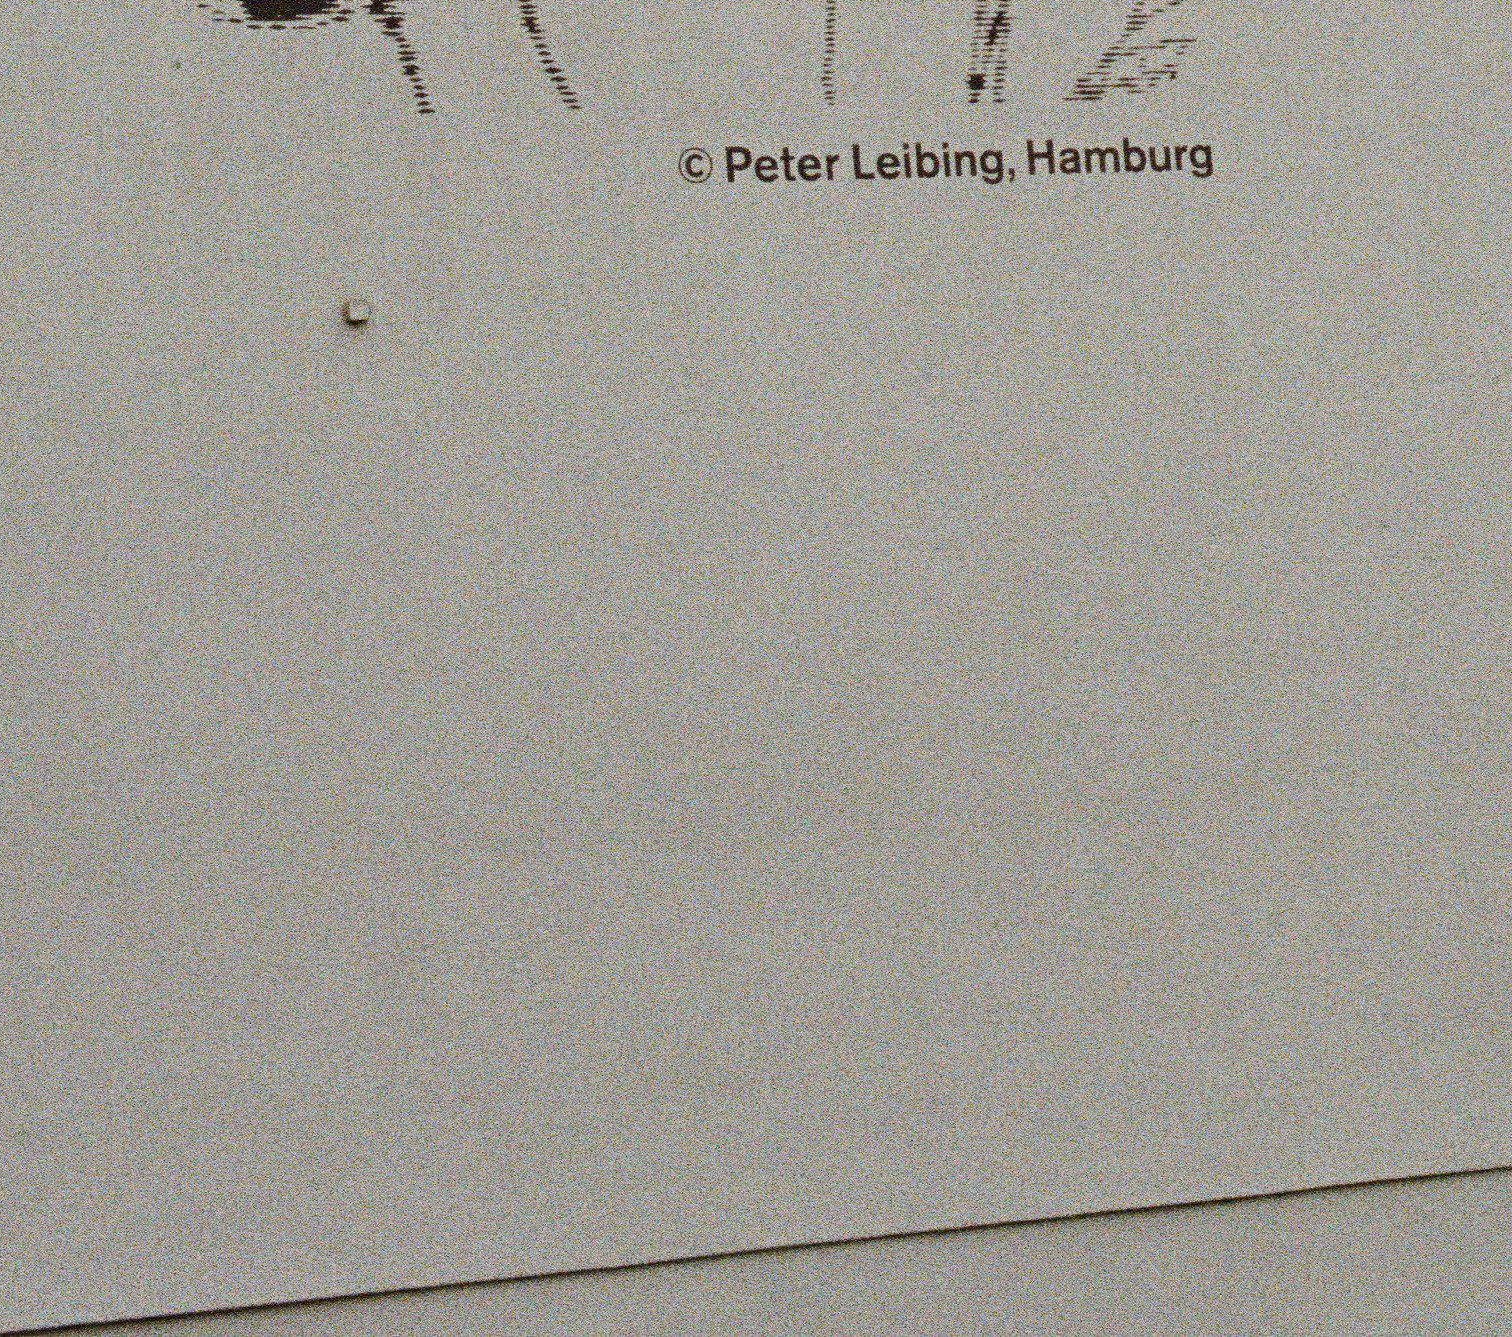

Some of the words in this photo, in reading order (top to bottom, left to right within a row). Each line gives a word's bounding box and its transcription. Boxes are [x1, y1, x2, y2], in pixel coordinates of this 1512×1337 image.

[724, 145, 841, 183] Peter
[851, 140, 1017, 185] Leibing,
[1026, 137, 1214, 178] Hamburg
